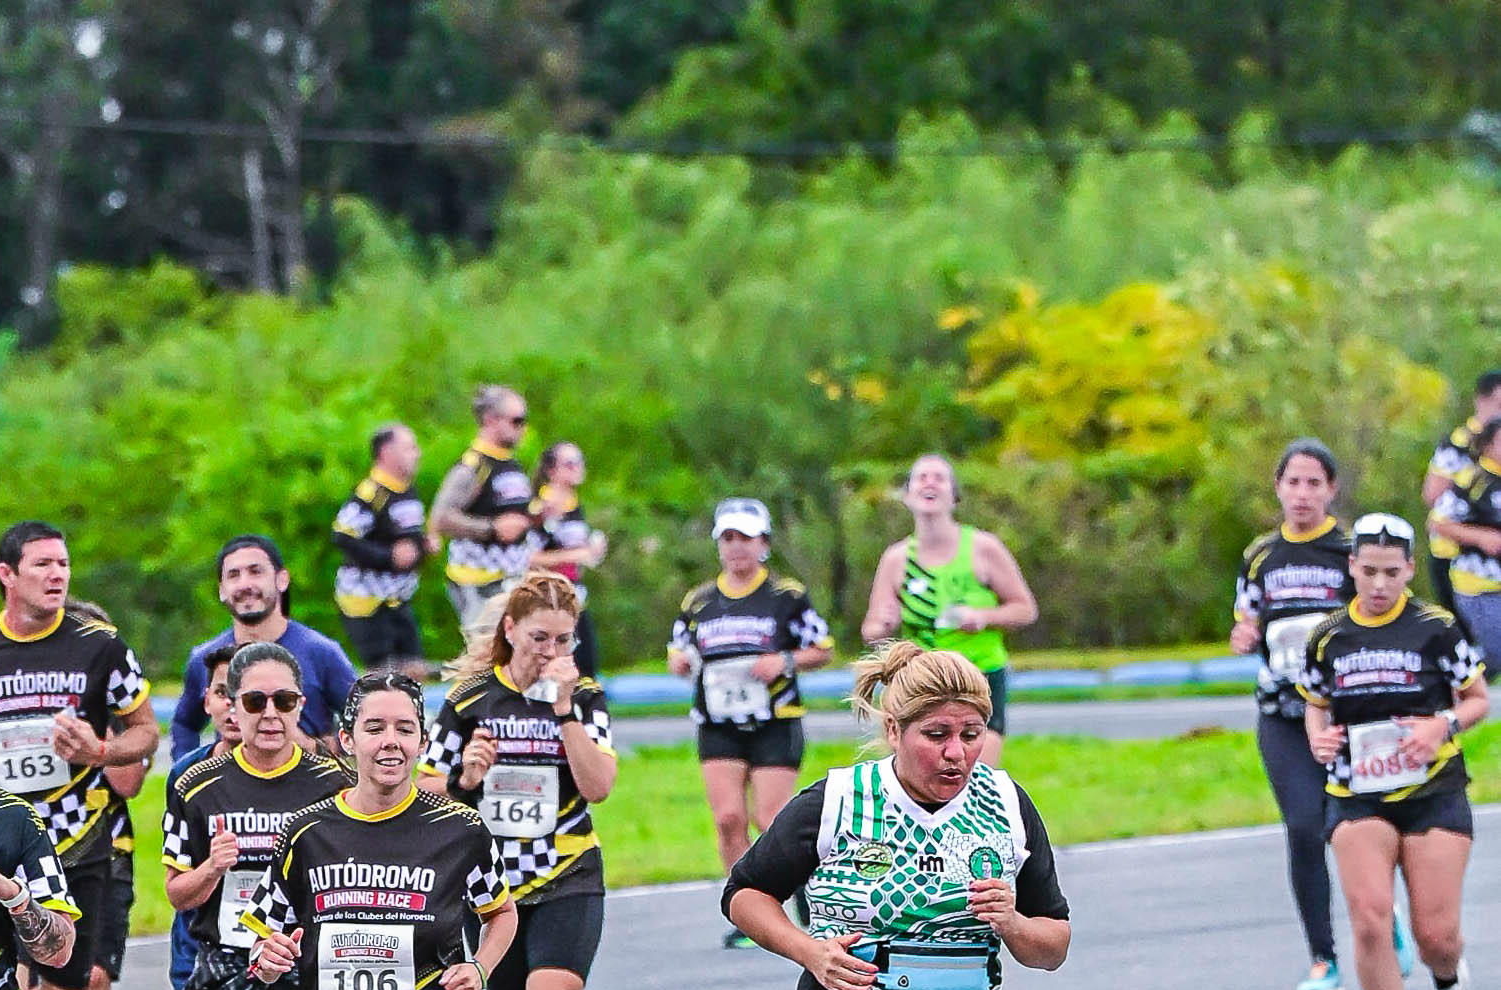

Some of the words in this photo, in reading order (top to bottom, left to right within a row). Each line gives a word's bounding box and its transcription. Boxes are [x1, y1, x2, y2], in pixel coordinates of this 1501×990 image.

[479, 714, 563, 740] TÓDROM
[3, 754, 55, 780] 163
[491, 801, 543, 824] 164
[236, 835, 273, 849] NNING
[308, 857, 436, 893] AUTÓDROMO
[323, 891, 375, 908] RUNNING
[377, 892, 412, 908] RACE
[335, 911, 343, 919] de
[345, 911, 356, 919] los
[358, 911, 383, 920] Clubes
[385, 911, 398, 920] del
[399, 912, 436, 921] Noroeste
[331, 929, 400, 949] AUTÓDROMO
